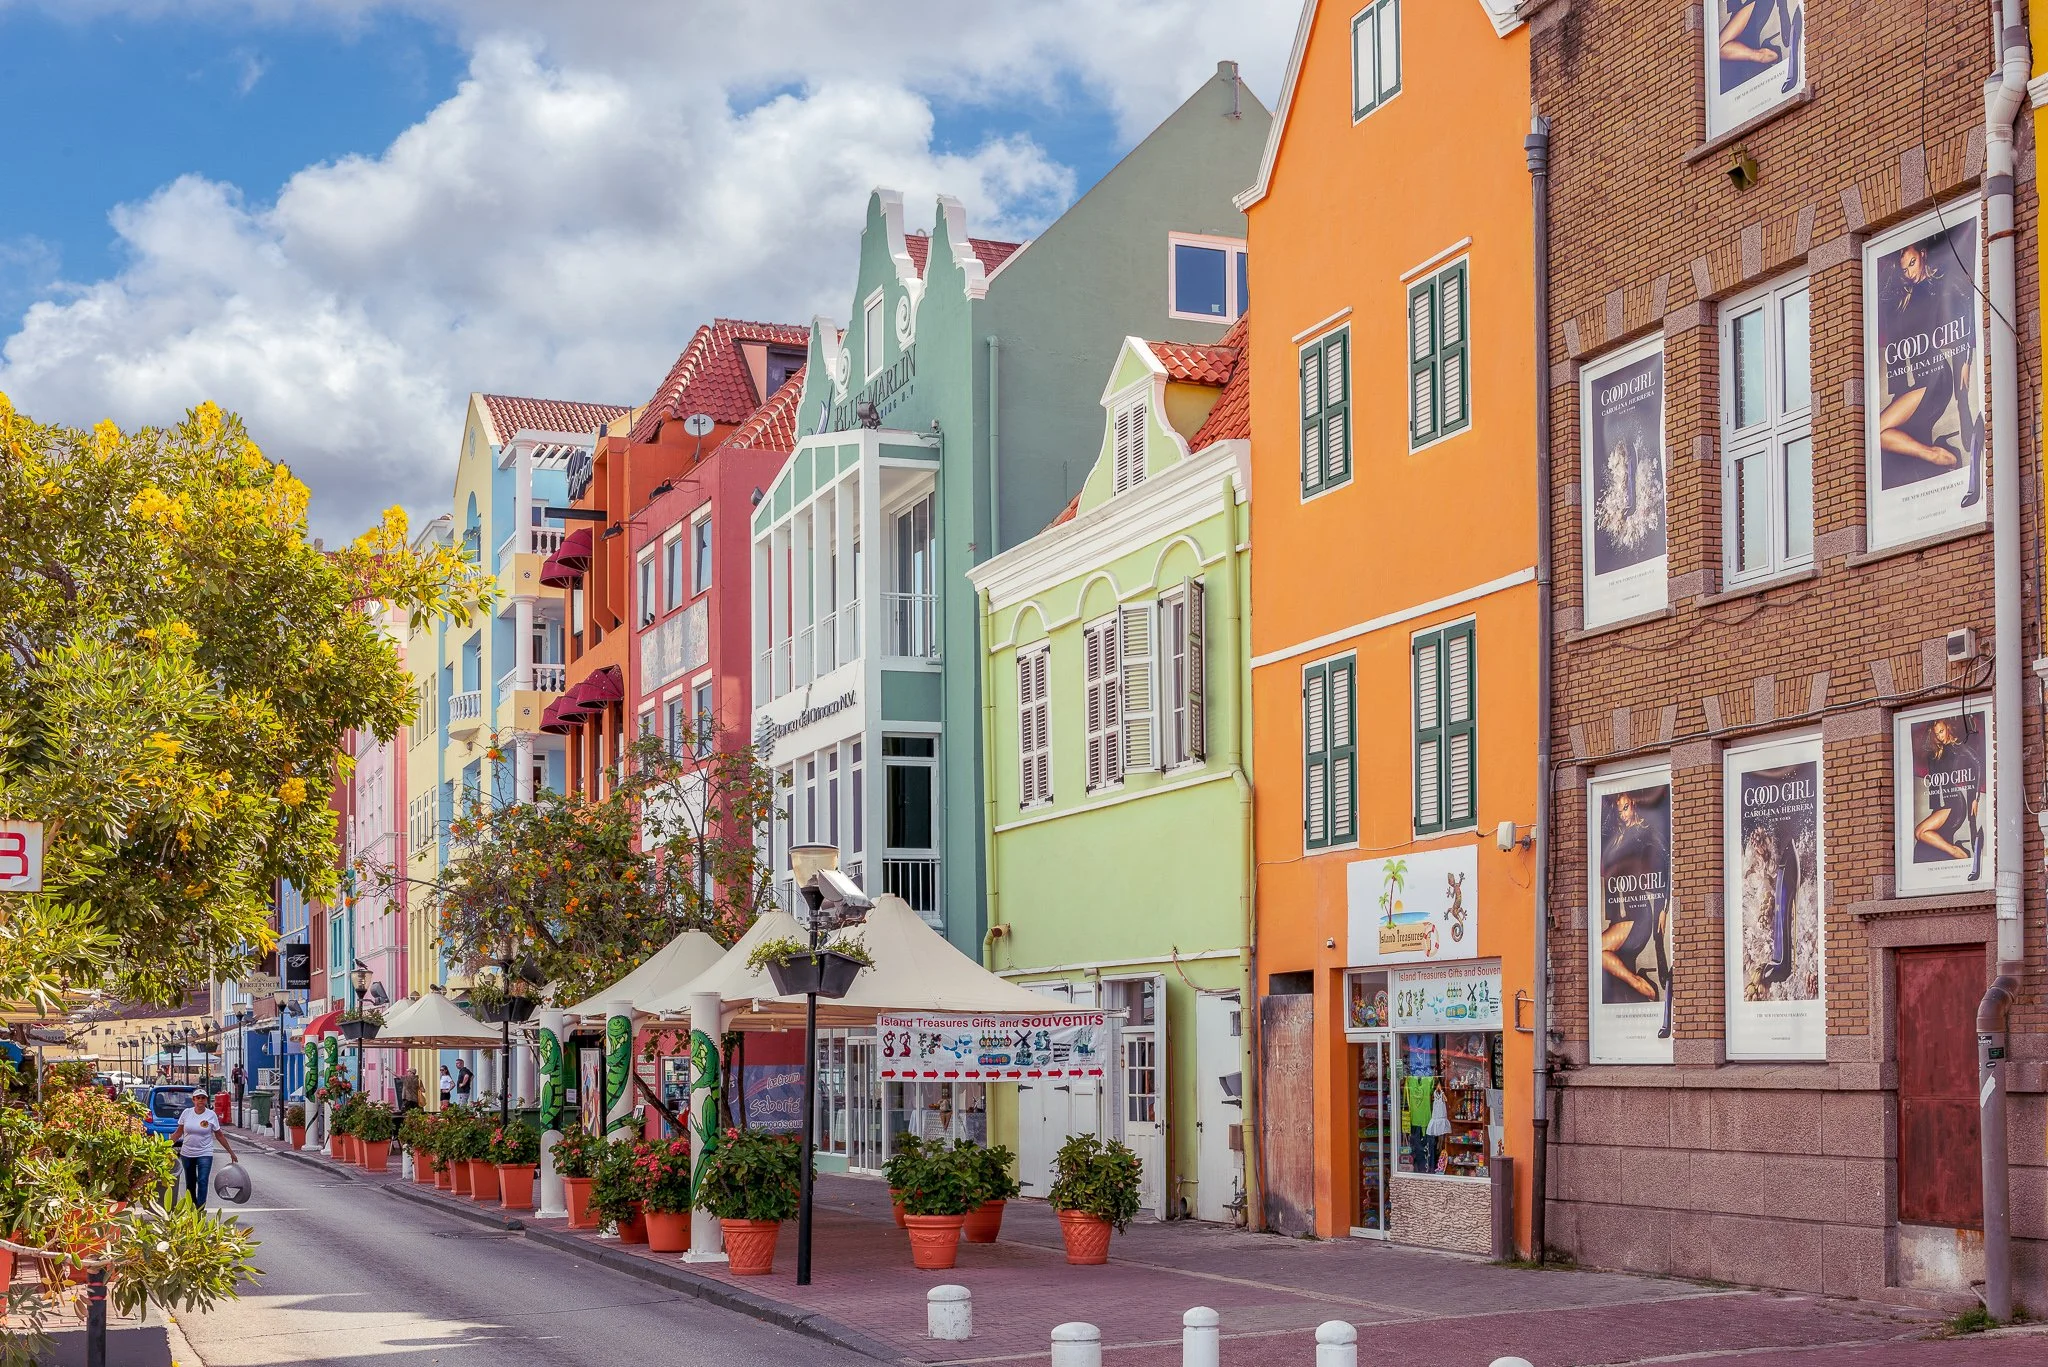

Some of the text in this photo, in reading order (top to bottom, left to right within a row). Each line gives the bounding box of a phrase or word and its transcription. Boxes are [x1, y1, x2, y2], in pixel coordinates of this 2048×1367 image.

[1884, 315, 1971, 365] GOOD GIRL
[1886, 342, 1971, 379] CAROLINA HERRERA
[867, 344, 917, 408] MARLIN
[1601, 371, 1656, 406] GOOD GIRL
[1601, 390, 1655, 417] CAROLINA HERRERA
[810, 700, 840, 724] Orinoco
[1923, 767, 1976, 788] GOOD GIRL
[1744, 779, 1815, 807] GOOD GIRL
[1744, 802, 1814, 818] CAROLINA HERRERA
[1607, 871, 1666, 894] GOOD GIRL
[1608, 892, 1665, 904] CAROLINA HERRERA
[1379, 929, 1424, 944] Island Treasures
[1398, 971, 1416, 982] Island
[1418, 970, 1447, 980] Treasures
[1448, 968, 1463, 978] Gifts
[1464, 968, 1476, 977] and
[881, 1012, 1104, 1028] Island Treasures Gifts and souvenirs
